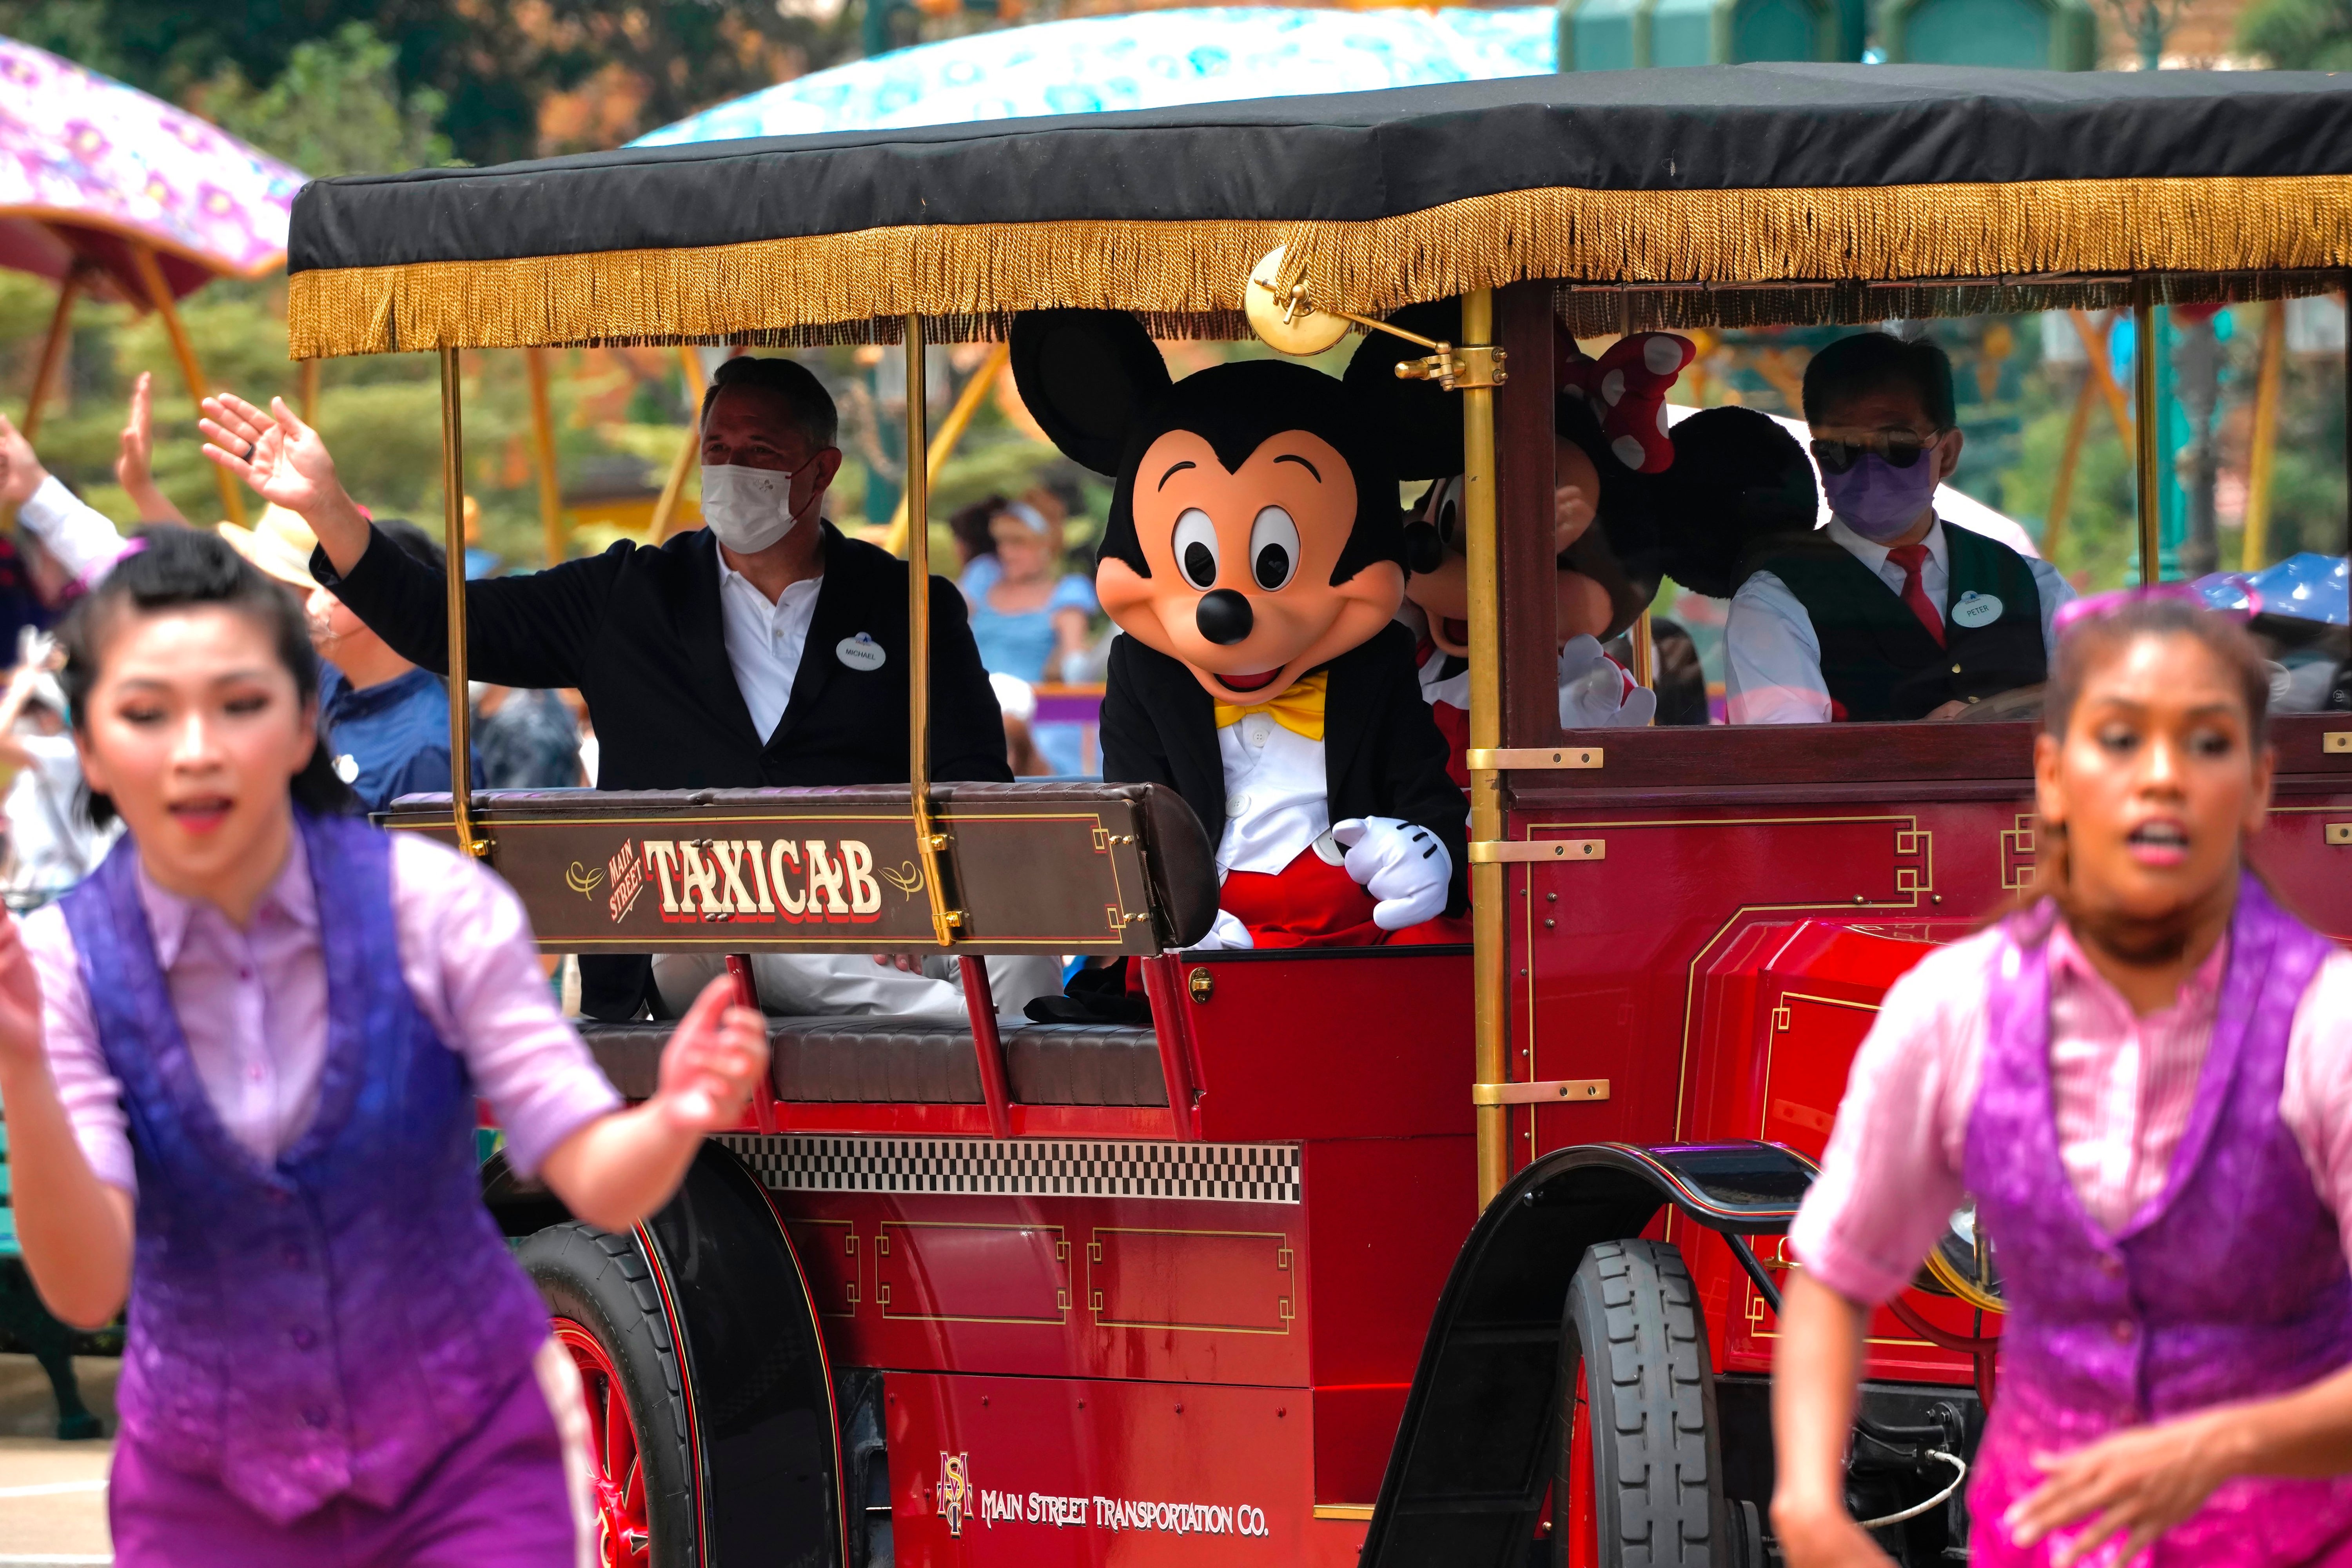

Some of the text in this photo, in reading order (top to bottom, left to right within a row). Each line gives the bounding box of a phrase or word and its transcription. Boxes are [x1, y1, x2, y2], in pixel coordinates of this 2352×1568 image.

[1967, 605, 1989, 617] PETER
[846, 648, 876, 661] MICHAEL
[608, 838, 633, 889] MAIN
[641, 838, 881, 923] TAXICAB
[609, 856, 642, 921] STREET
[981, 1490, 1269, 1537] MAIN STREET TRANSPORTATION CO.
